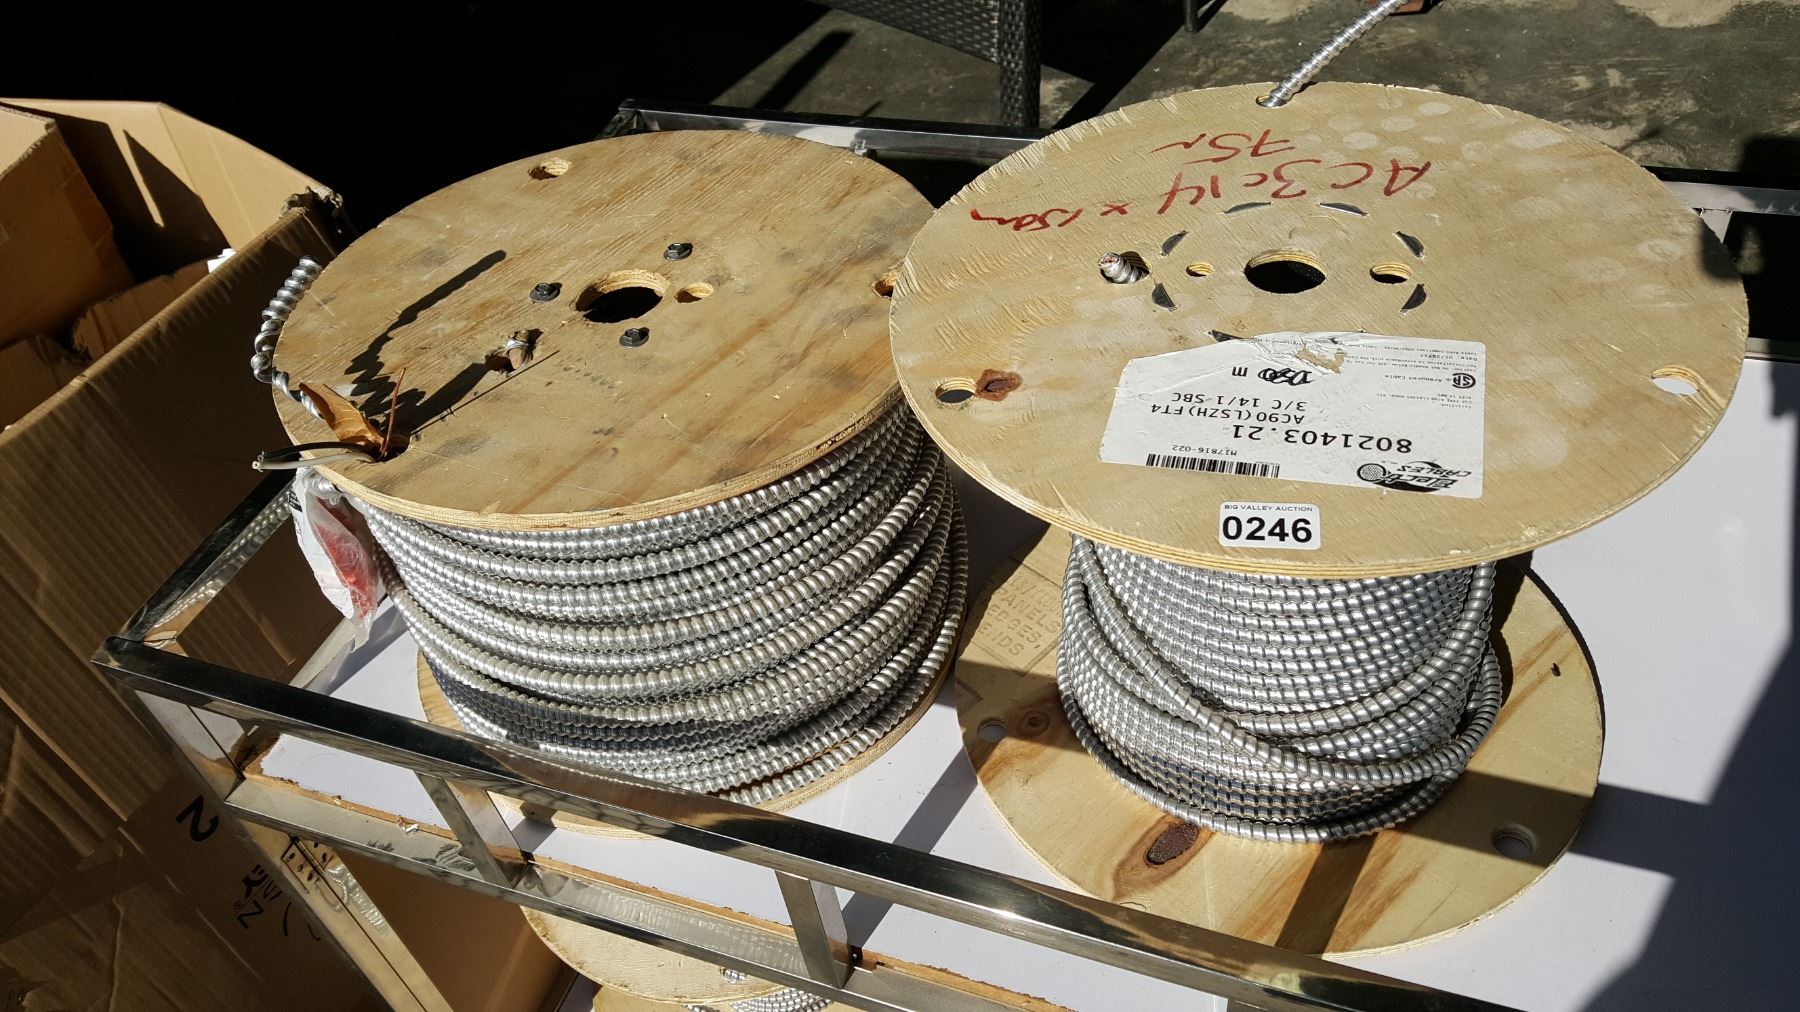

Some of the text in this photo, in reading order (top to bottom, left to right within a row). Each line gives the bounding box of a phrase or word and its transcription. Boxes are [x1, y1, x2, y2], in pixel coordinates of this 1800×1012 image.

[1231, 366, 1248, 377] m
[1171, 392, 1307, 412] 3/C 14/1 SBC
[1232, 424, 1413, 453] 8021403.21
[1171, 444, 1238, 457] M17816-022
[1396, 465, 1472, 478] CABLES
[1222, 516, 1312, 543] 0246
